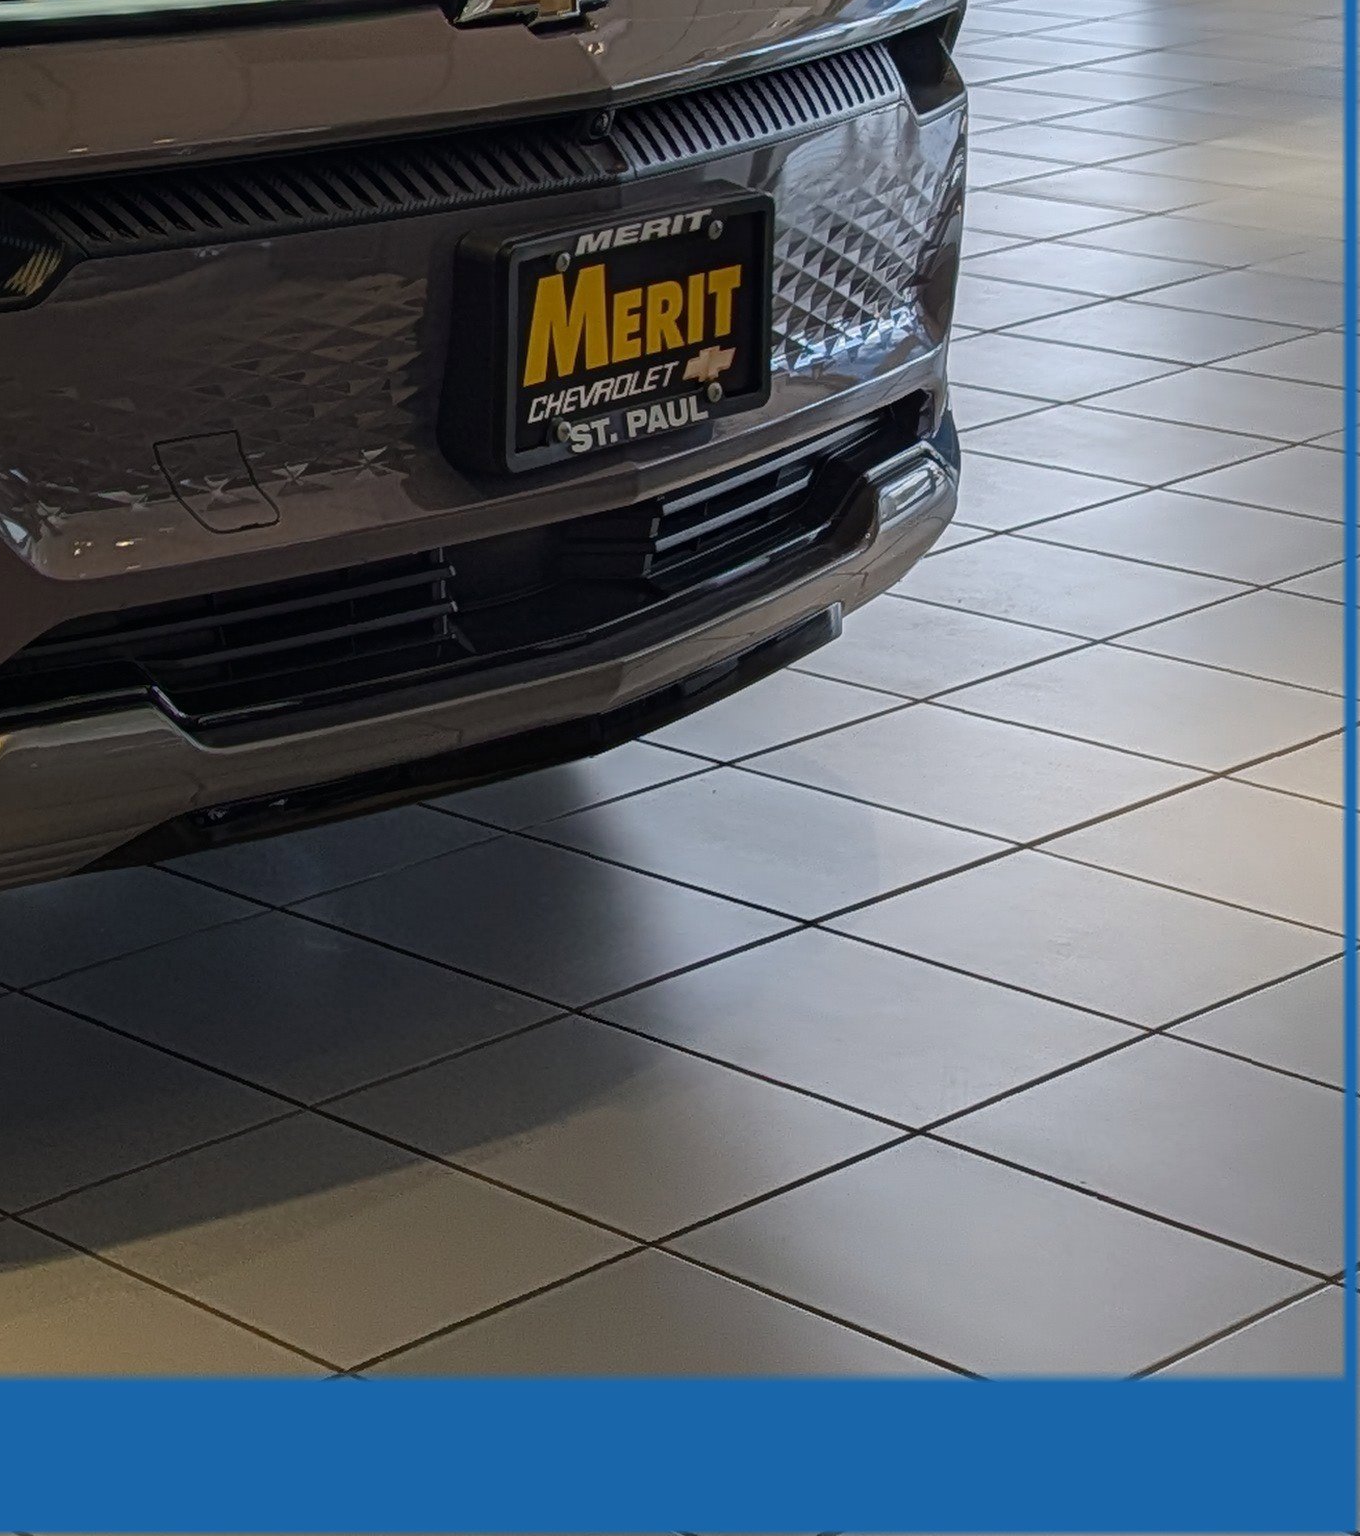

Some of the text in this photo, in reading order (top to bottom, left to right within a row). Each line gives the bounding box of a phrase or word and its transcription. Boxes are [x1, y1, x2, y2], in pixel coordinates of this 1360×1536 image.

[574, 209, 713, 256] MERIT
[523, 264, 742, 387] MERIT
[527, 360, 680, 425] CHEVROLET
[571, 395, 709, 454] ST. PAUL
